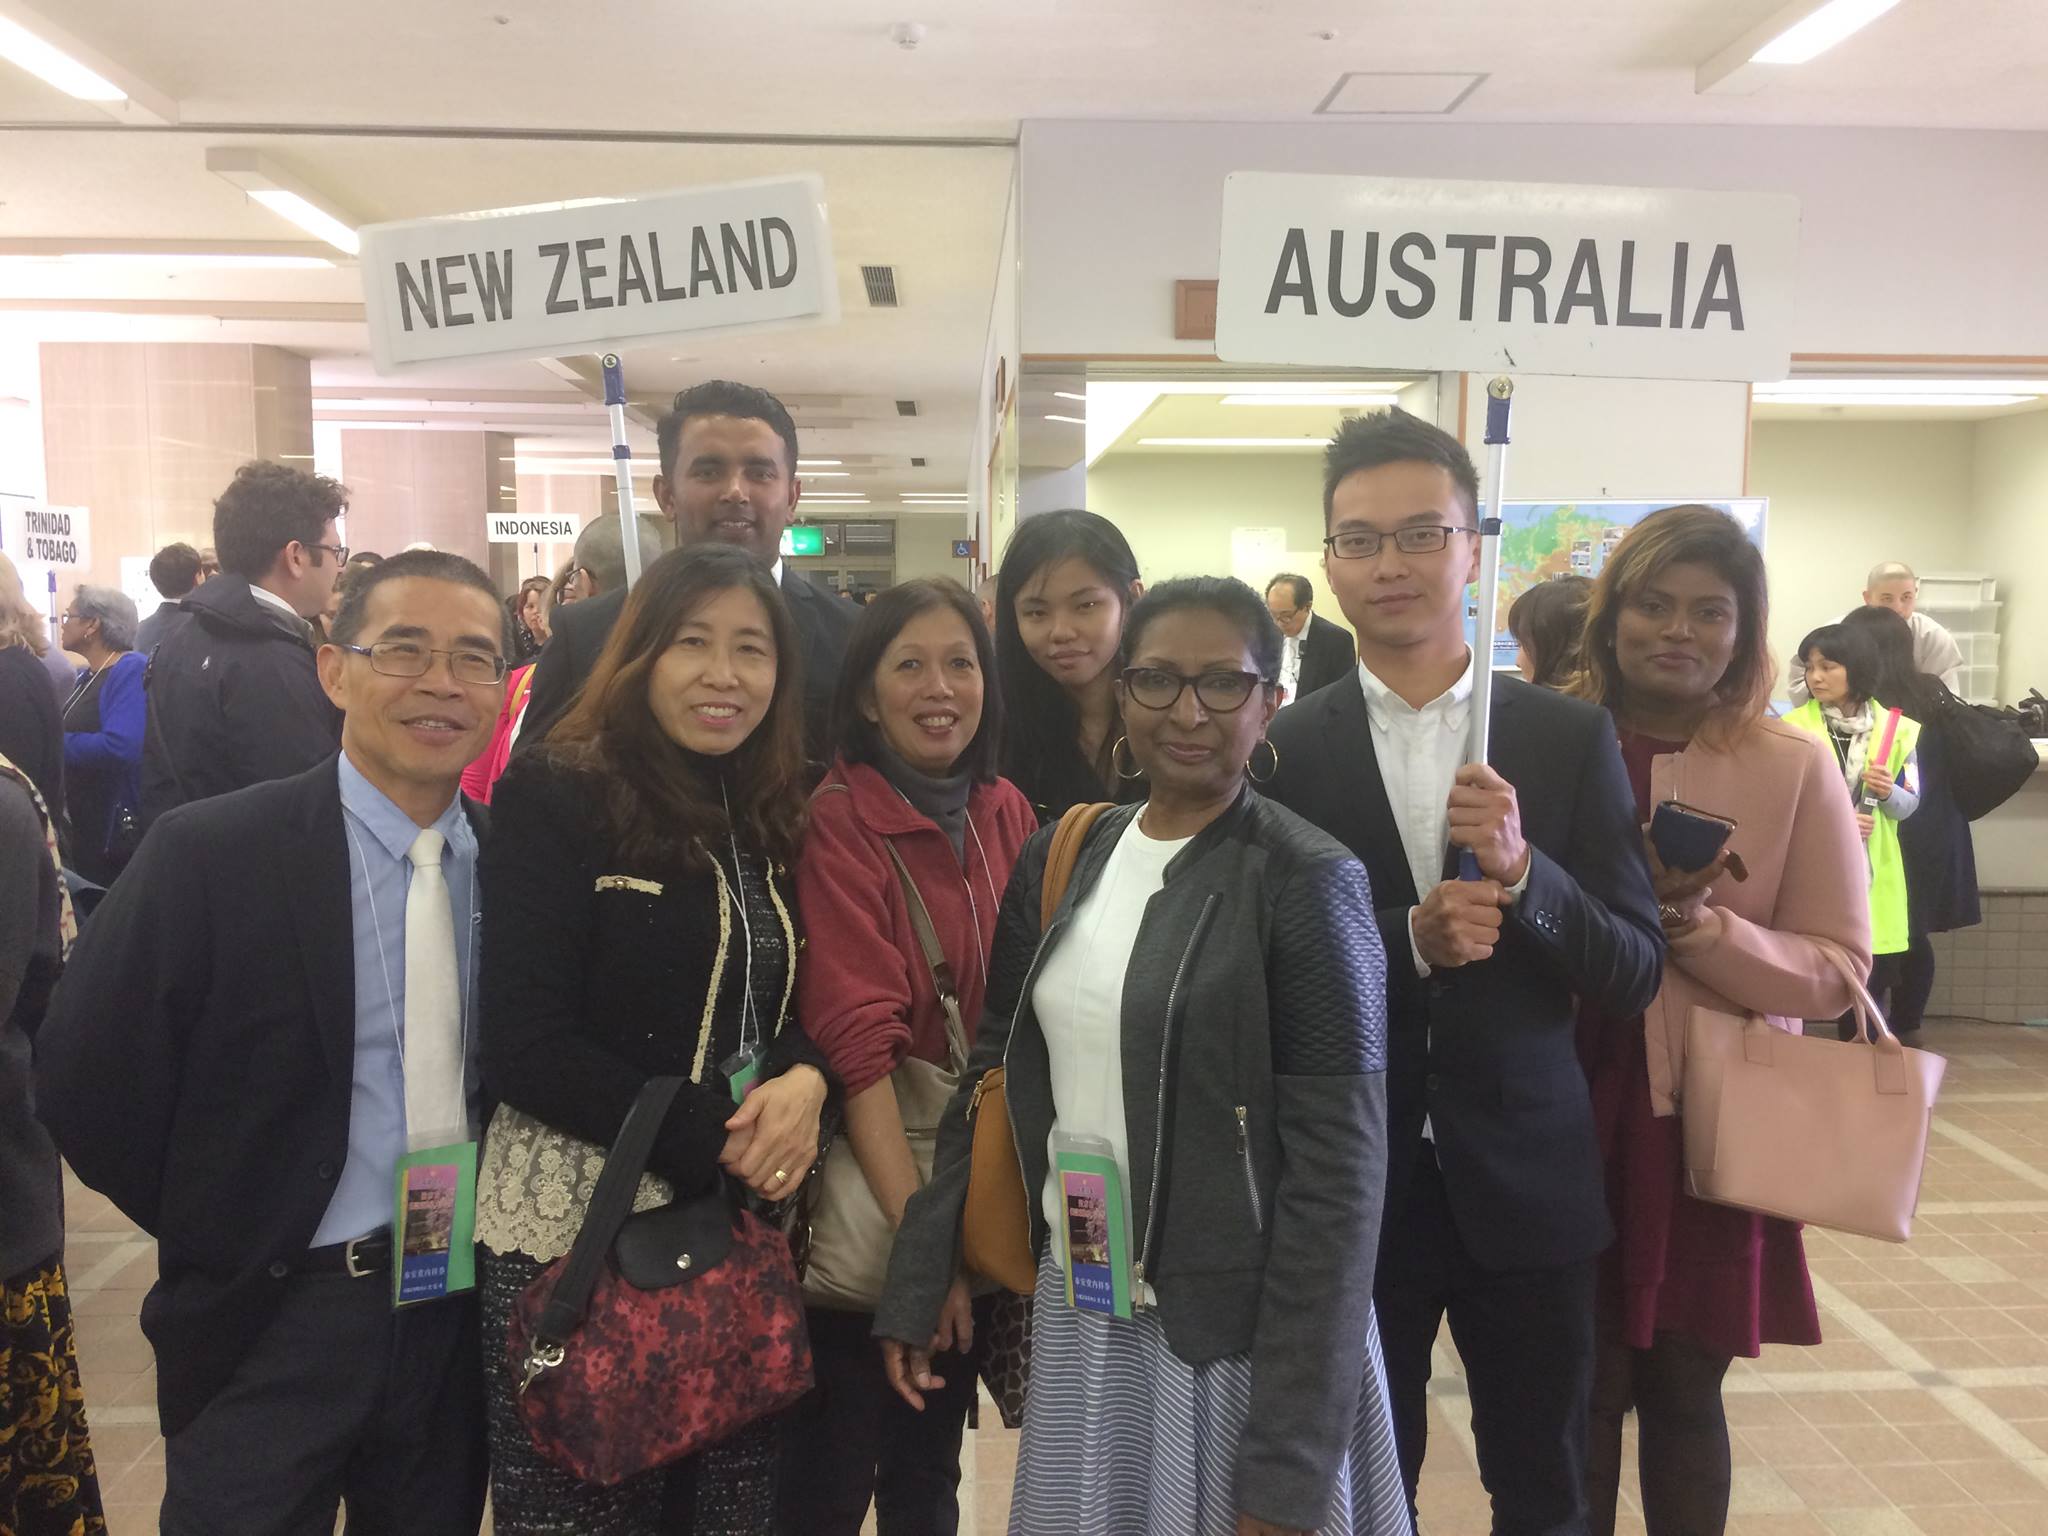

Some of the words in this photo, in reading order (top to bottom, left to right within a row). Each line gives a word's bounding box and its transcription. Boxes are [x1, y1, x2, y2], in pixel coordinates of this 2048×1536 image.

[395, 248, 512, 332] NEW
[538, 216, 798, 315] ZEALAND
[1263, 227, 1745, 331] AUSTRALIA
[25, 511, 71, 536] TRINIDAD
[495, 521, 573, 535] INDONESIA
[27, 537, 34, 559] &
[36, 538, 77, 564] TOBAGO
